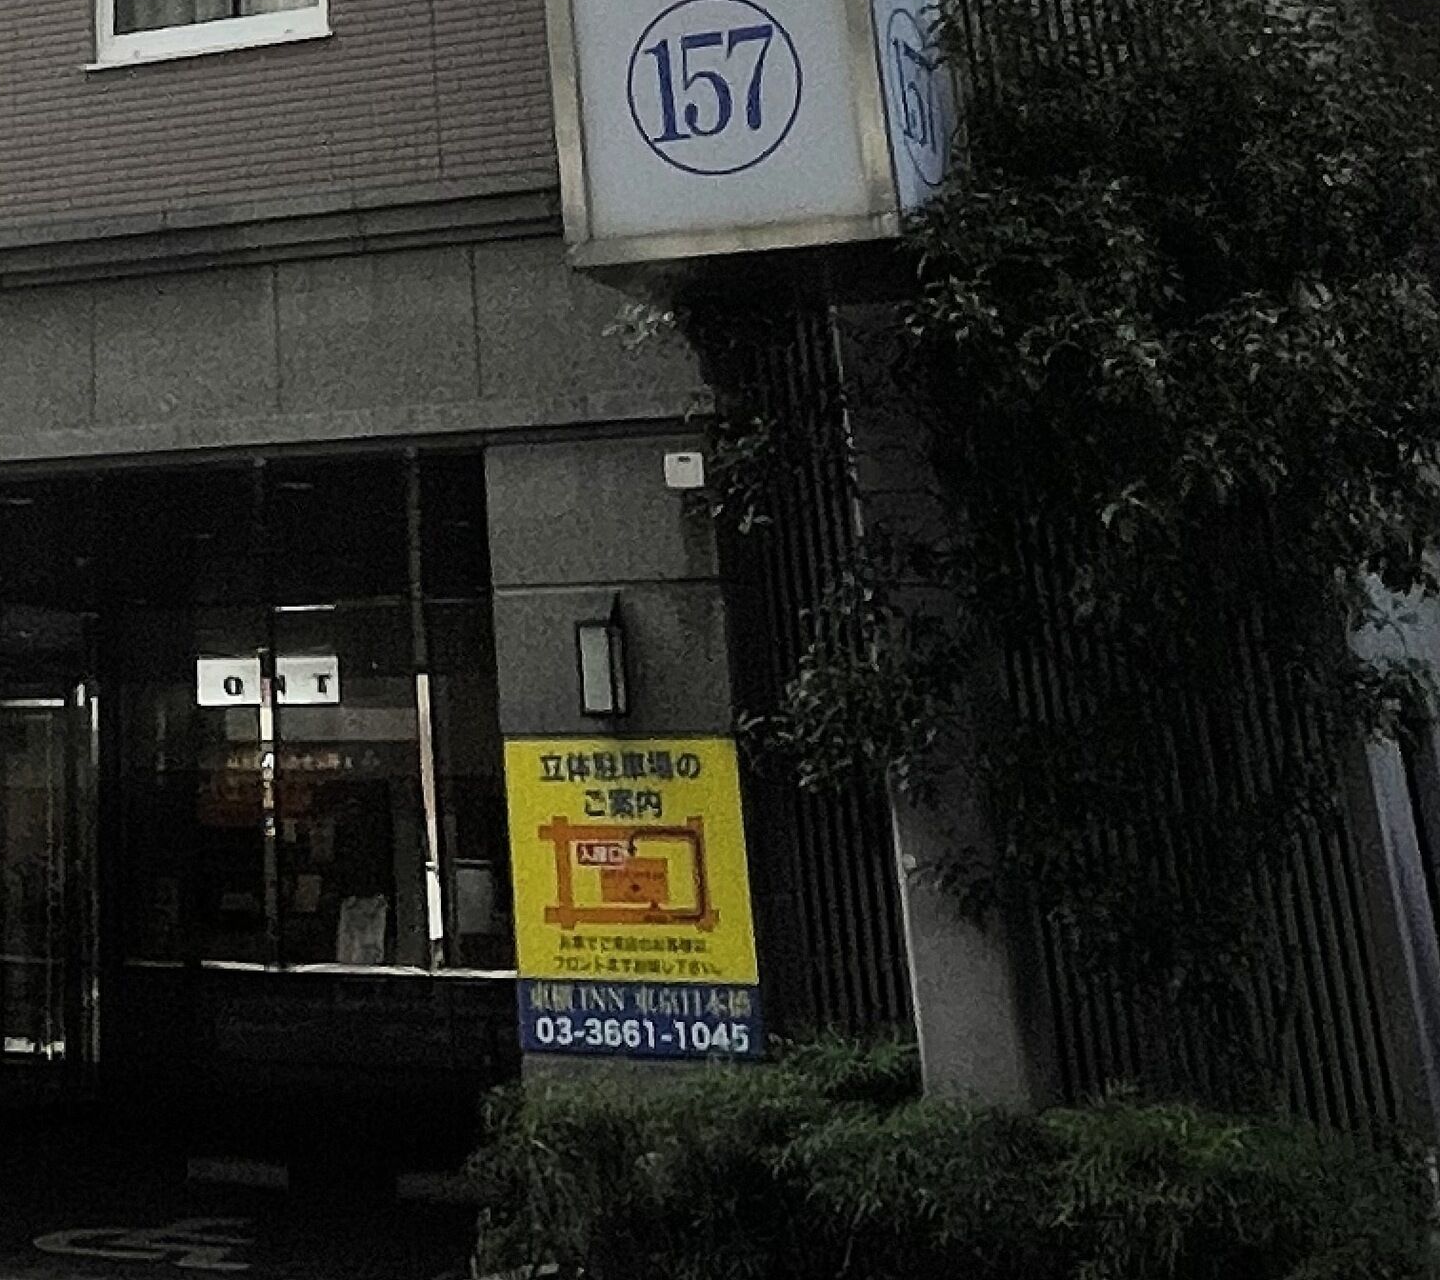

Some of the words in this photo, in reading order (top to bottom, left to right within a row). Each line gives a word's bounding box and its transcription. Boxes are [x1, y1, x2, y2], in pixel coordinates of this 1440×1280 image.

[643, 22, 774, 144] 157
[539, 750, 701, 783] 立体駐車場の
[583, 788, 664, 818] ご案内
[535, 1016, 750, 1052] 03-3661-1045
